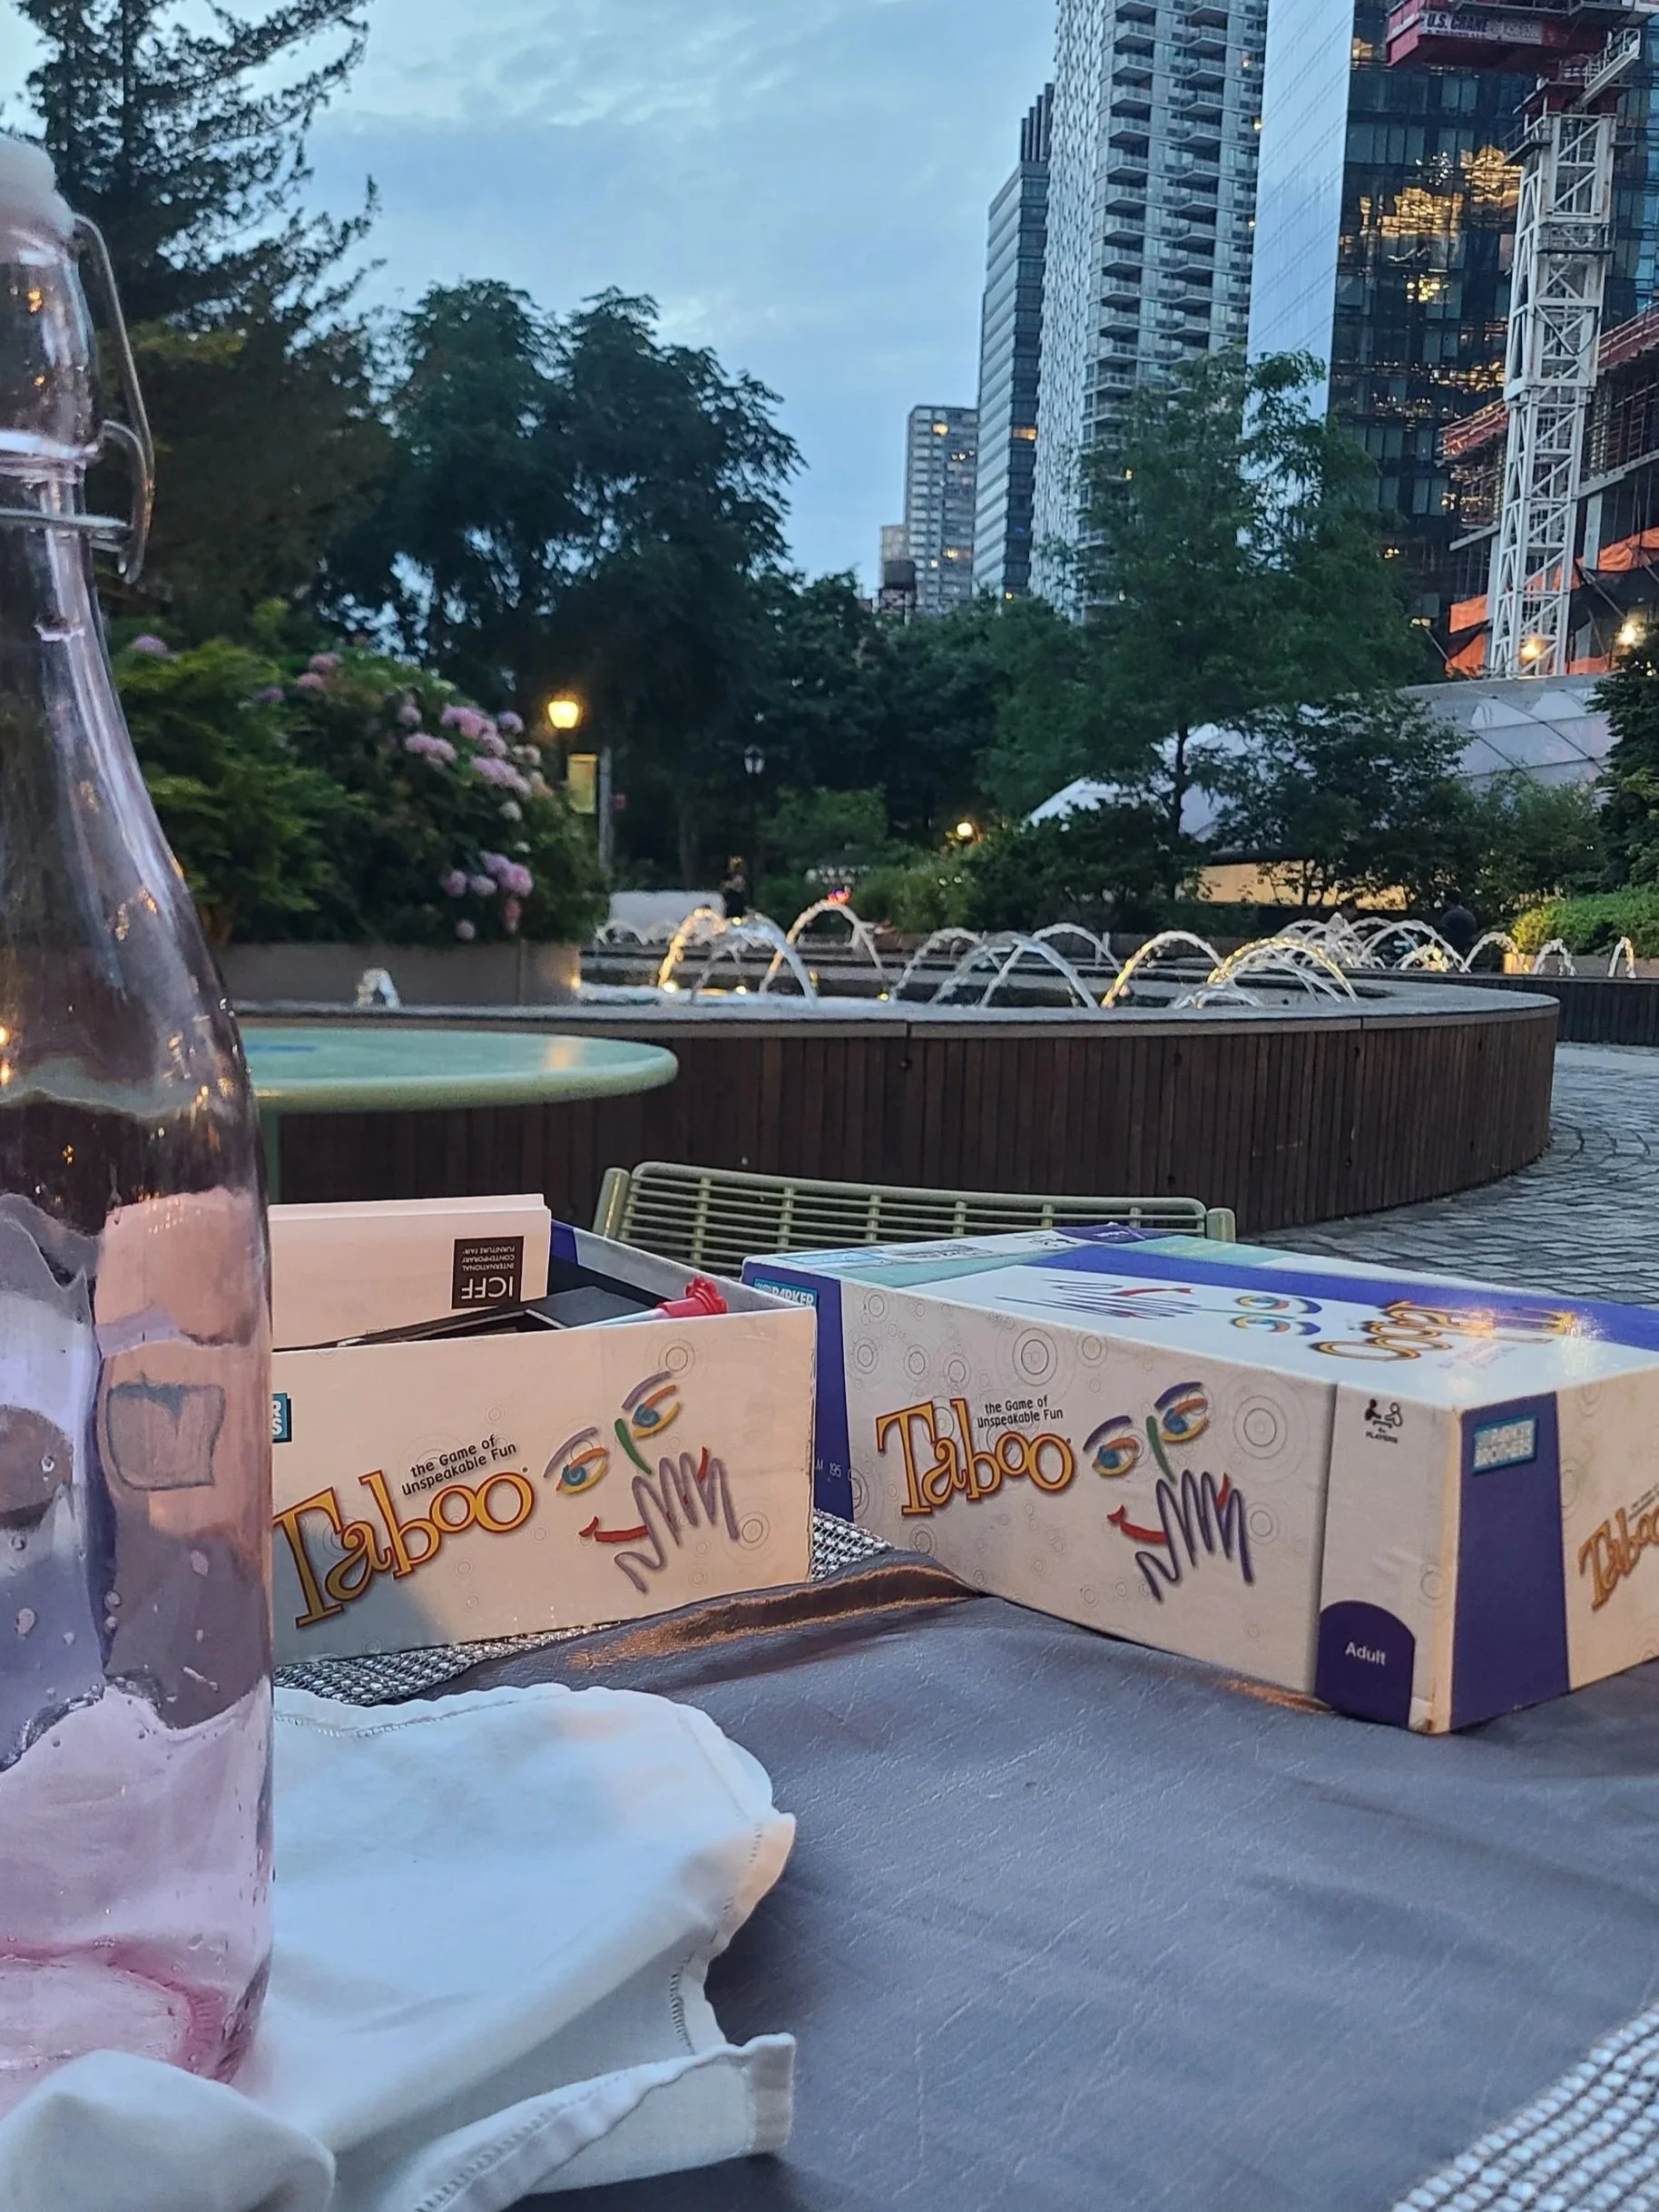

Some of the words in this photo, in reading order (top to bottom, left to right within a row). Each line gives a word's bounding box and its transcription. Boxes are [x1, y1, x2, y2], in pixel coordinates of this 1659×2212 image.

[1427, 13, 1448, 29] U.S.
[1451, 15, 1487, 32] CRANE
[461, 1254, 515, 1264] CONTEMPORARY
[462, 1262, 515, 1272] INTERNATIONAL
[461, 1276, 514, 1300] ICFF
[985, 1403, 1002, 1414] the
[1006, 1399, 1034, 1412] Game
[1036, 1395, 1048, 1408] of
[977, 1410, 1041, 1429] Unspeakable
[1044, 1407, 1064, 1422] Fun
[410, 1461, 435, 1479] the
[438, 1444, 477, 1466] Game
[481, 1434, 496, 1450] of
[876, 1398, 1075, 1515] Taboo
[401, 1455, 487, 1496] Unspeakable
[491, 1444, 517, 1461] Fun
[272, 1470, 535, 1630] Taboo
[1345, 1641, 1387, 1666] Adult
